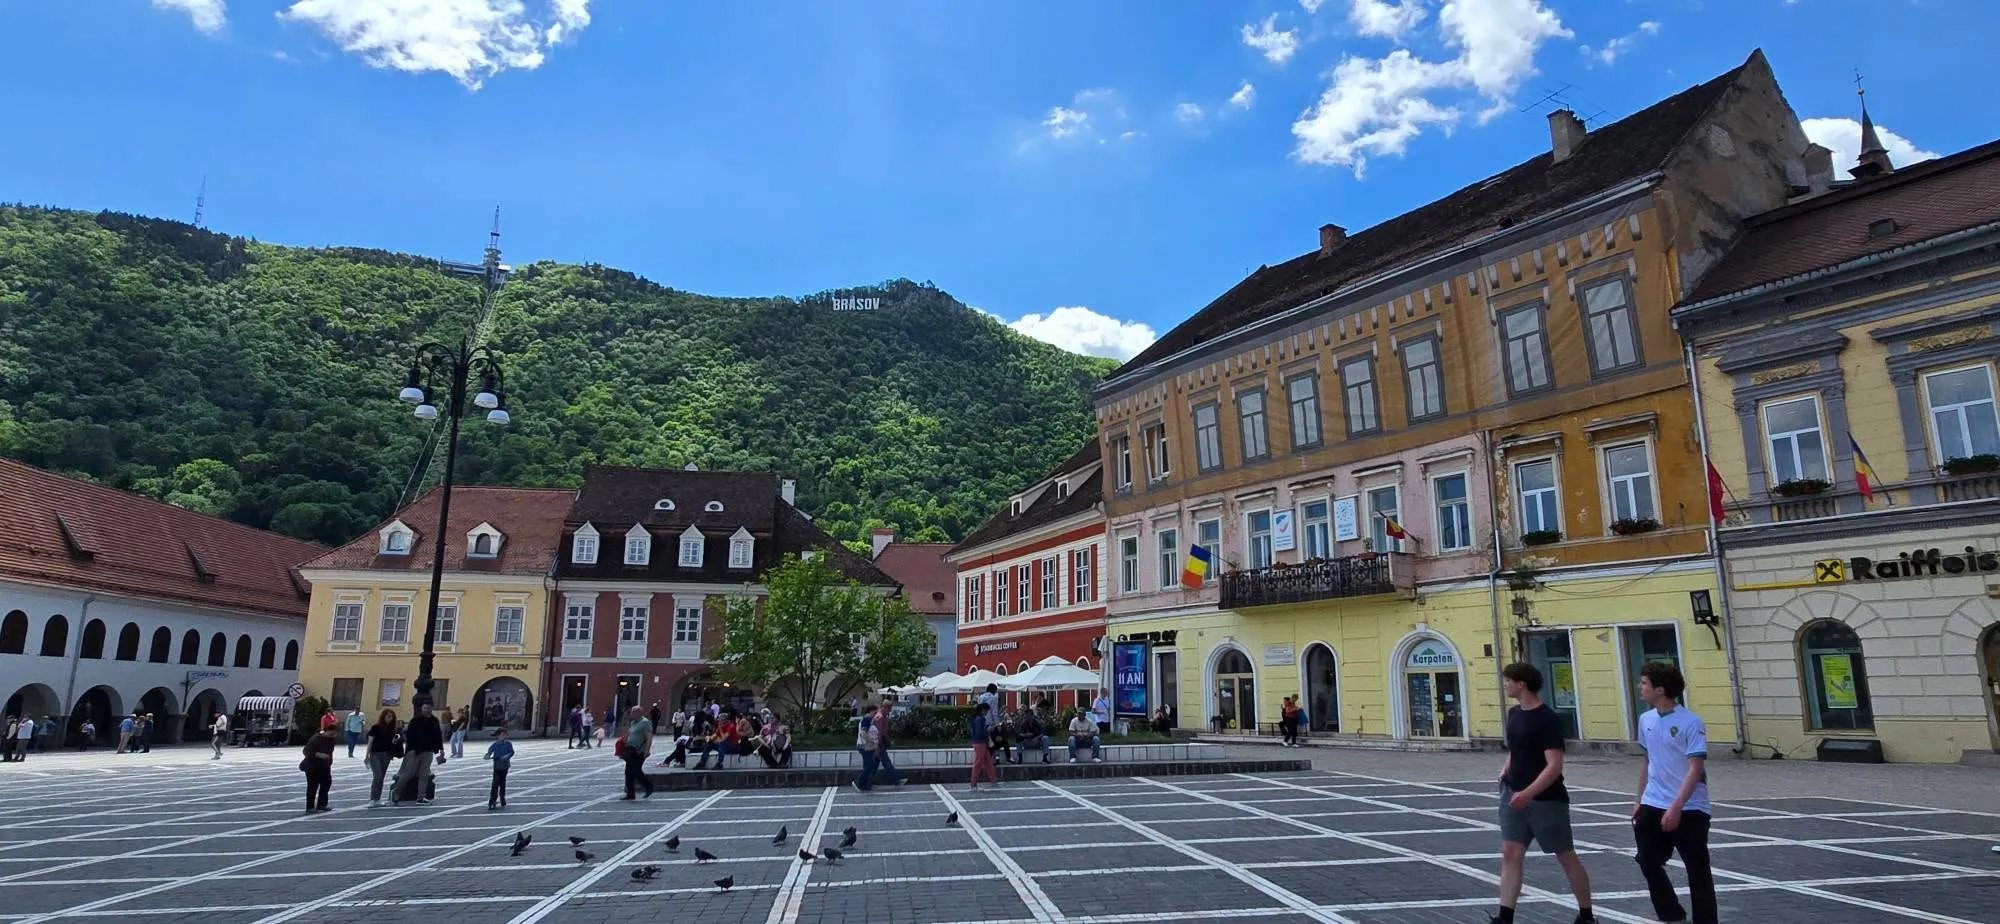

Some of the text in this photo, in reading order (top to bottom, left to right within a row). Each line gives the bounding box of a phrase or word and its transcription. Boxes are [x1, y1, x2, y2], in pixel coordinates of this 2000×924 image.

[833, 297, 880, 311] BRASOV
[1413, 653, 1453, 665] Karpaten
[485, 663, 528, 671] MUSEUM
[1126, 672, 1145, 685] ANI
